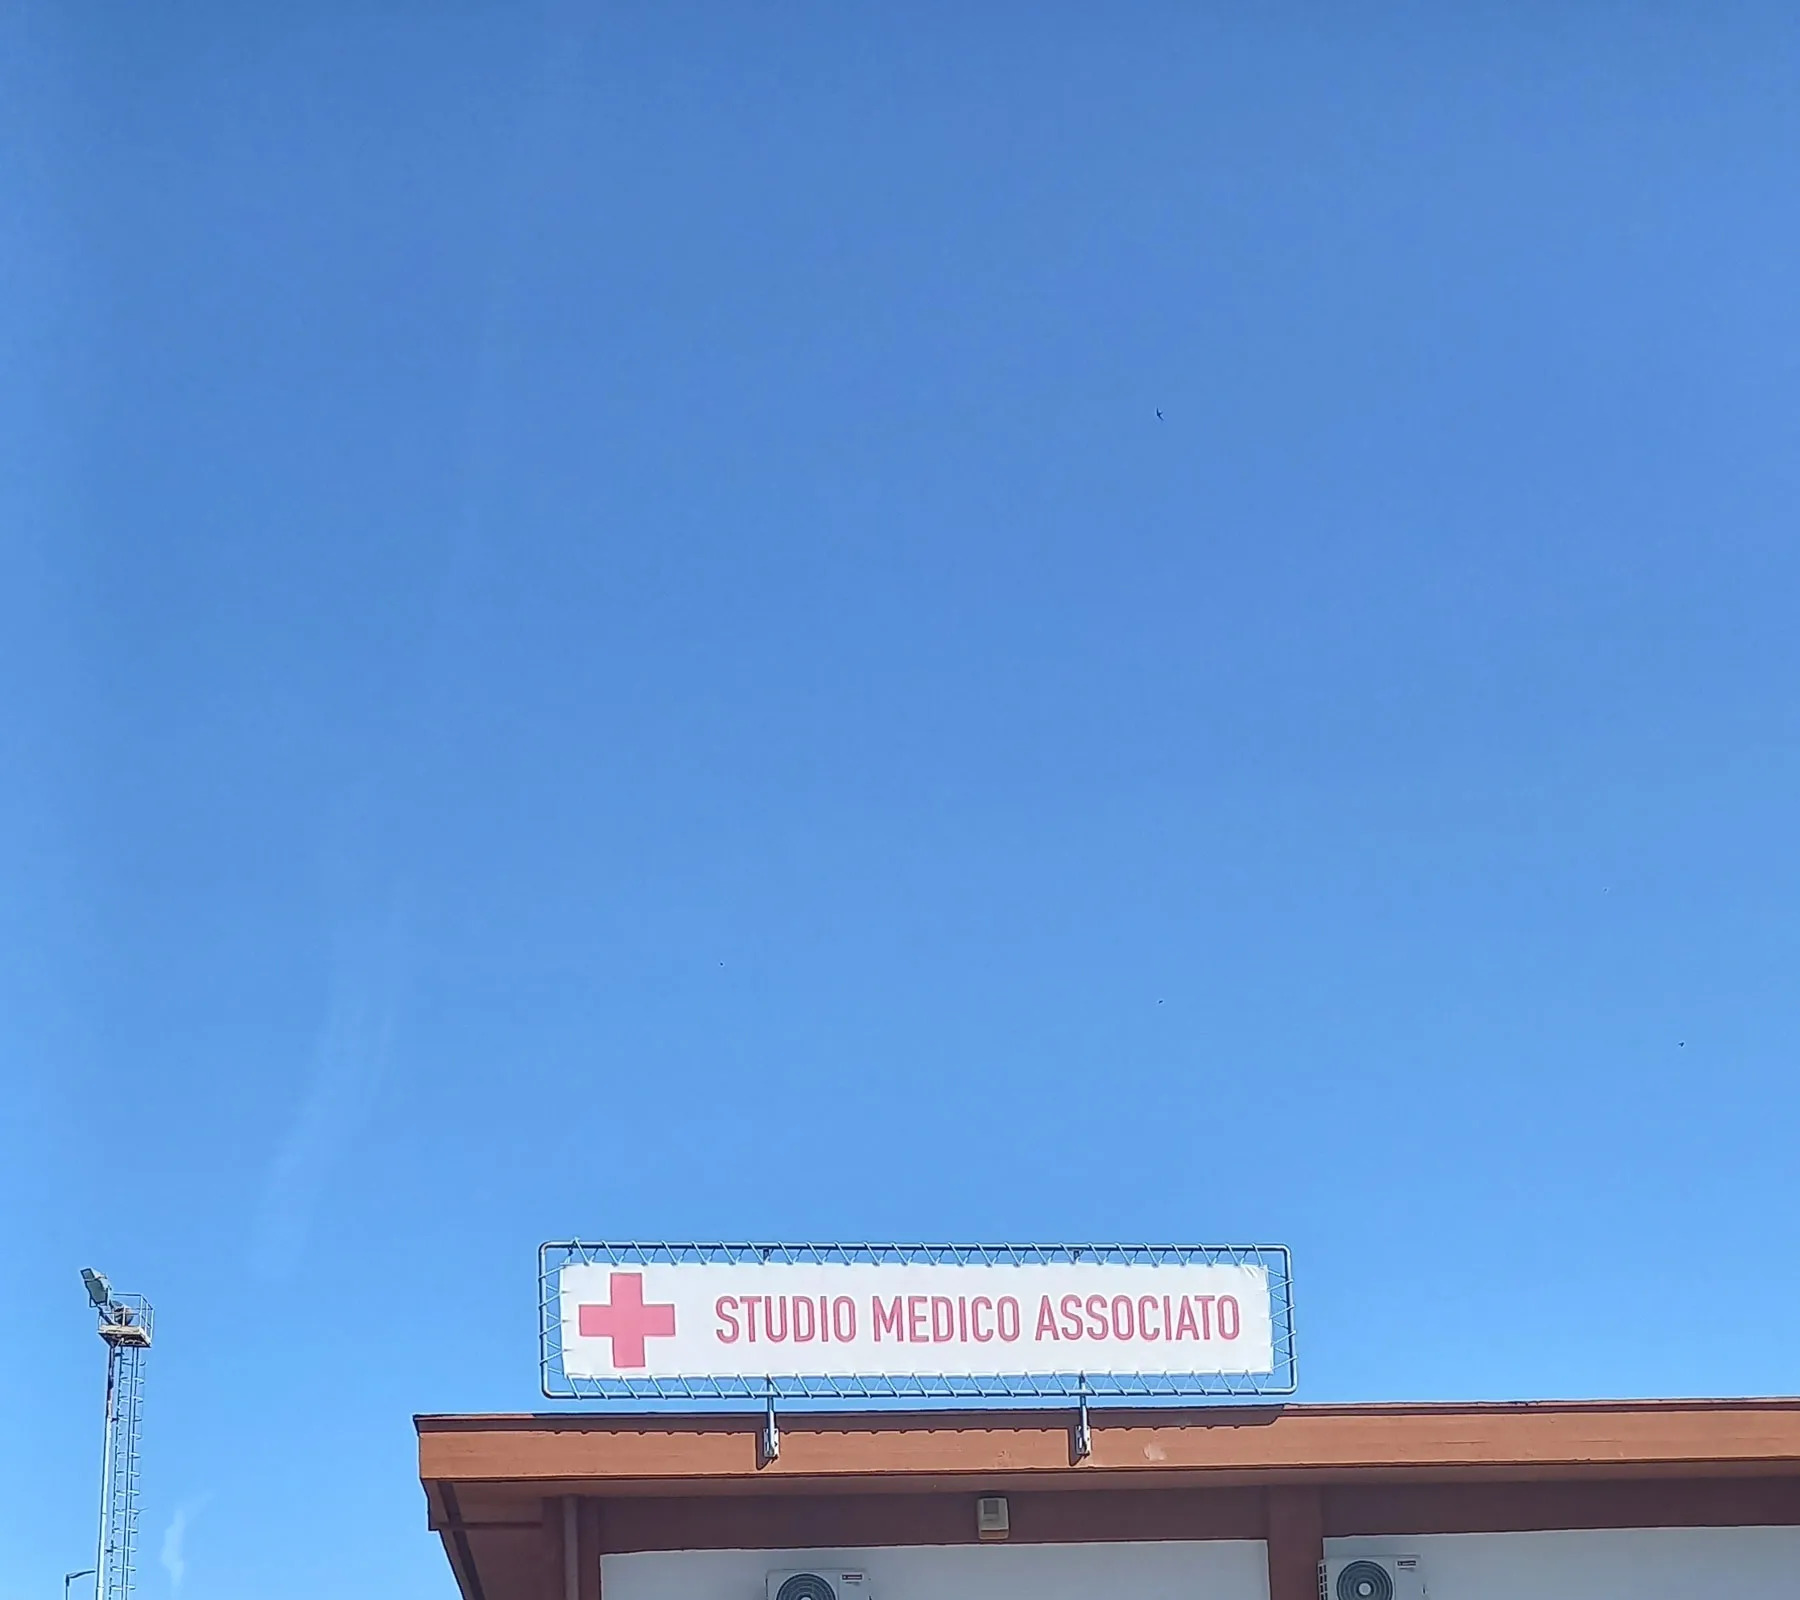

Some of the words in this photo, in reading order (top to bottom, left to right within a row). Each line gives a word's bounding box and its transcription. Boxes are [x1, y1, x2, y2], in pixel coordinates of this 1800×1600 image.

[715, 1295, 857, 1344] STUDIO
[871, 1295, 1020, 1344] MEDICO
[1035, 1294, 1241, 1342] ASSOCIATO
